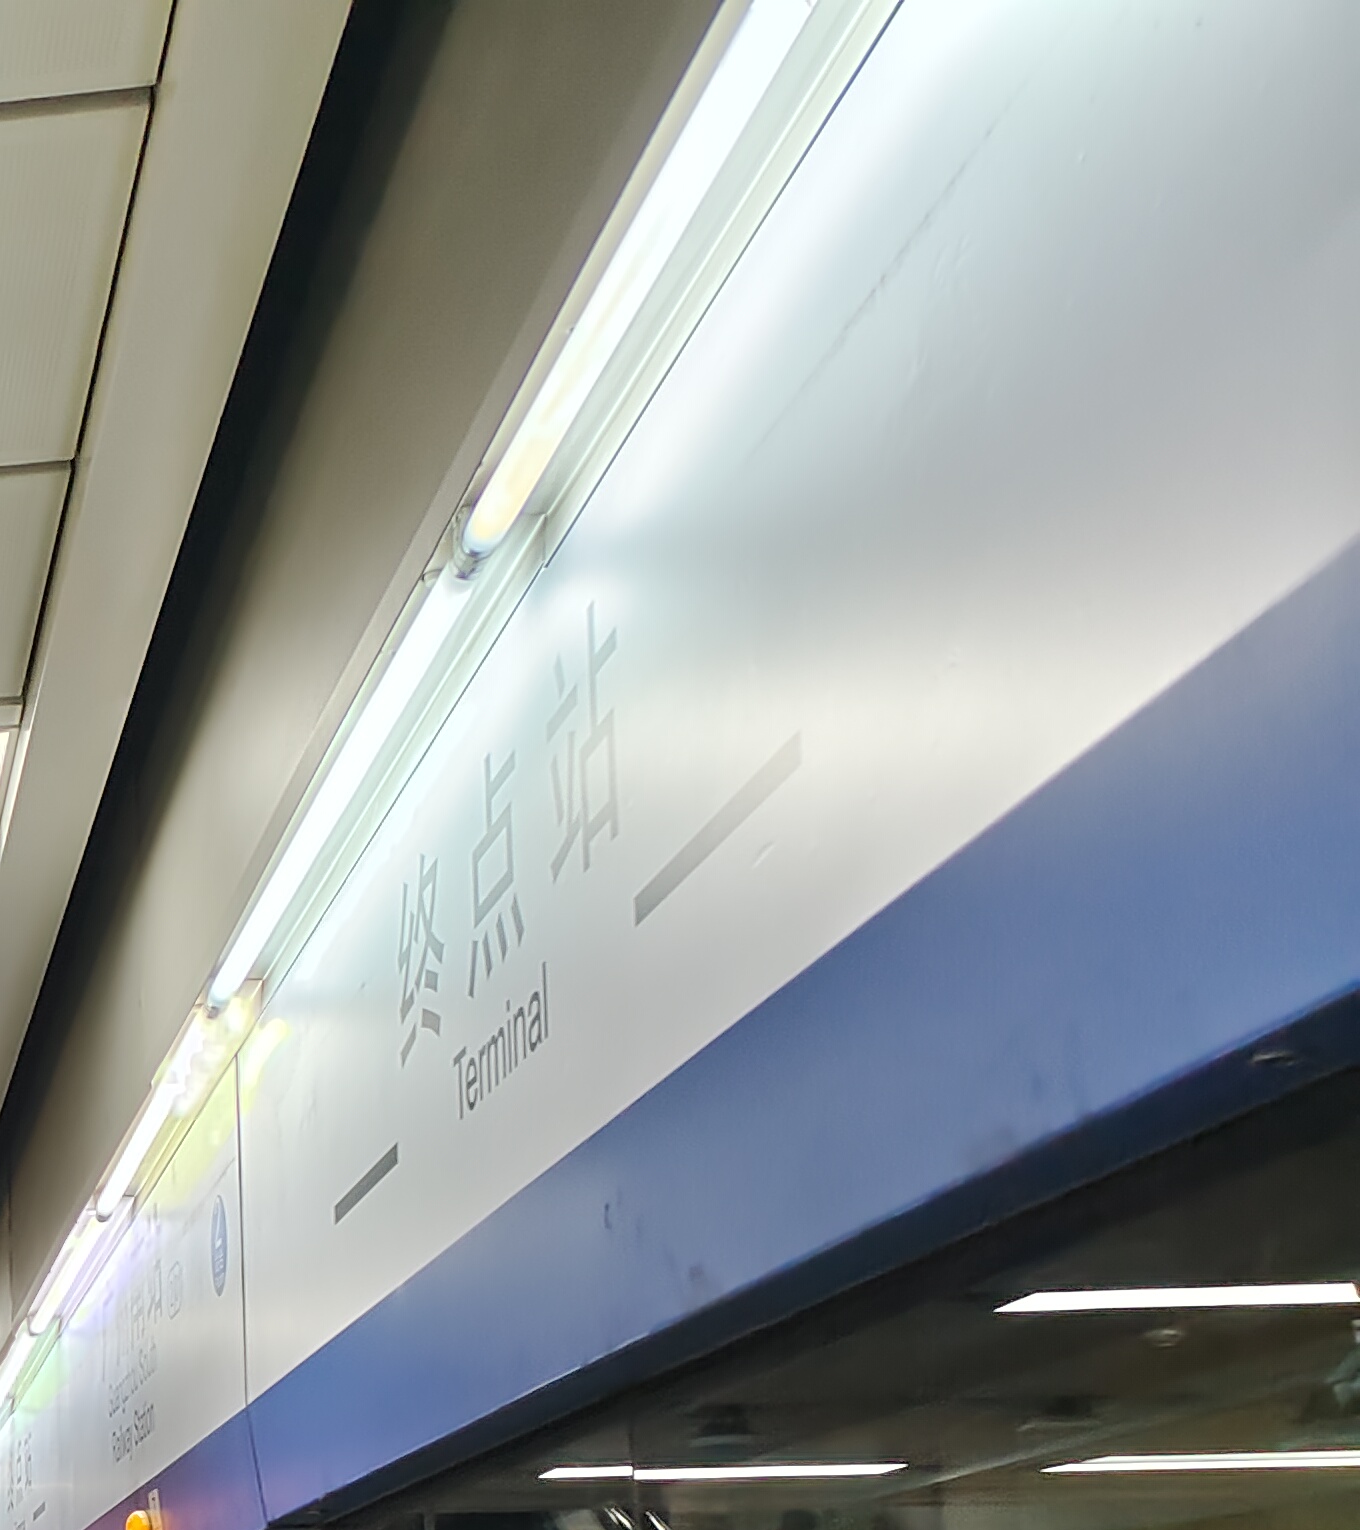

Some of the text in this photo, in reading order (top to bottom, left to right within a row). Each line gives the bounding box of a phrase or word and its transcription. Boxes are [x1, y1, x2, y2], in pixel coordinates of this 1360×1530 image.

[397, 601, 619, 1068] 终点站
[452, 961, 550, 1120] Terminal
